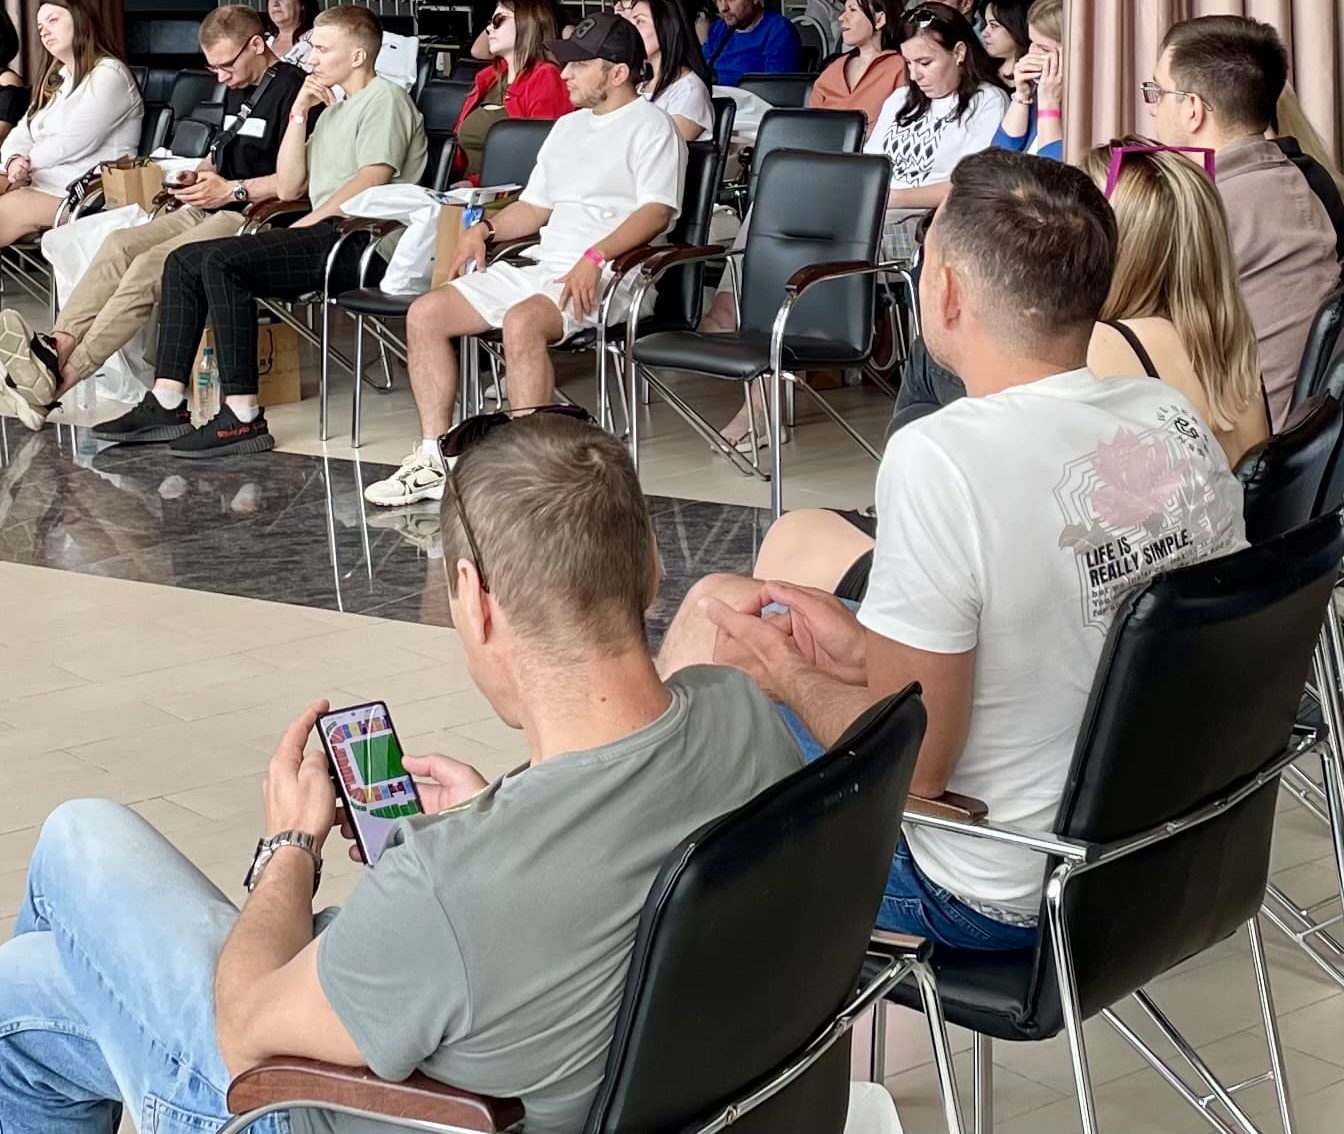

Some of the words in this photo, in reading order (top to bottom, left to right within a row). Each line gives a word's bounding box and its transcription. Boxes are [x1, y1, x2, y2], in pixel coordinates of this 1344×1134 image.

[1086, 542, 1115, 568] LIFE
[1117, 536, 1131, 556] IS
[1088, 552, 1139, 588] REALLY
